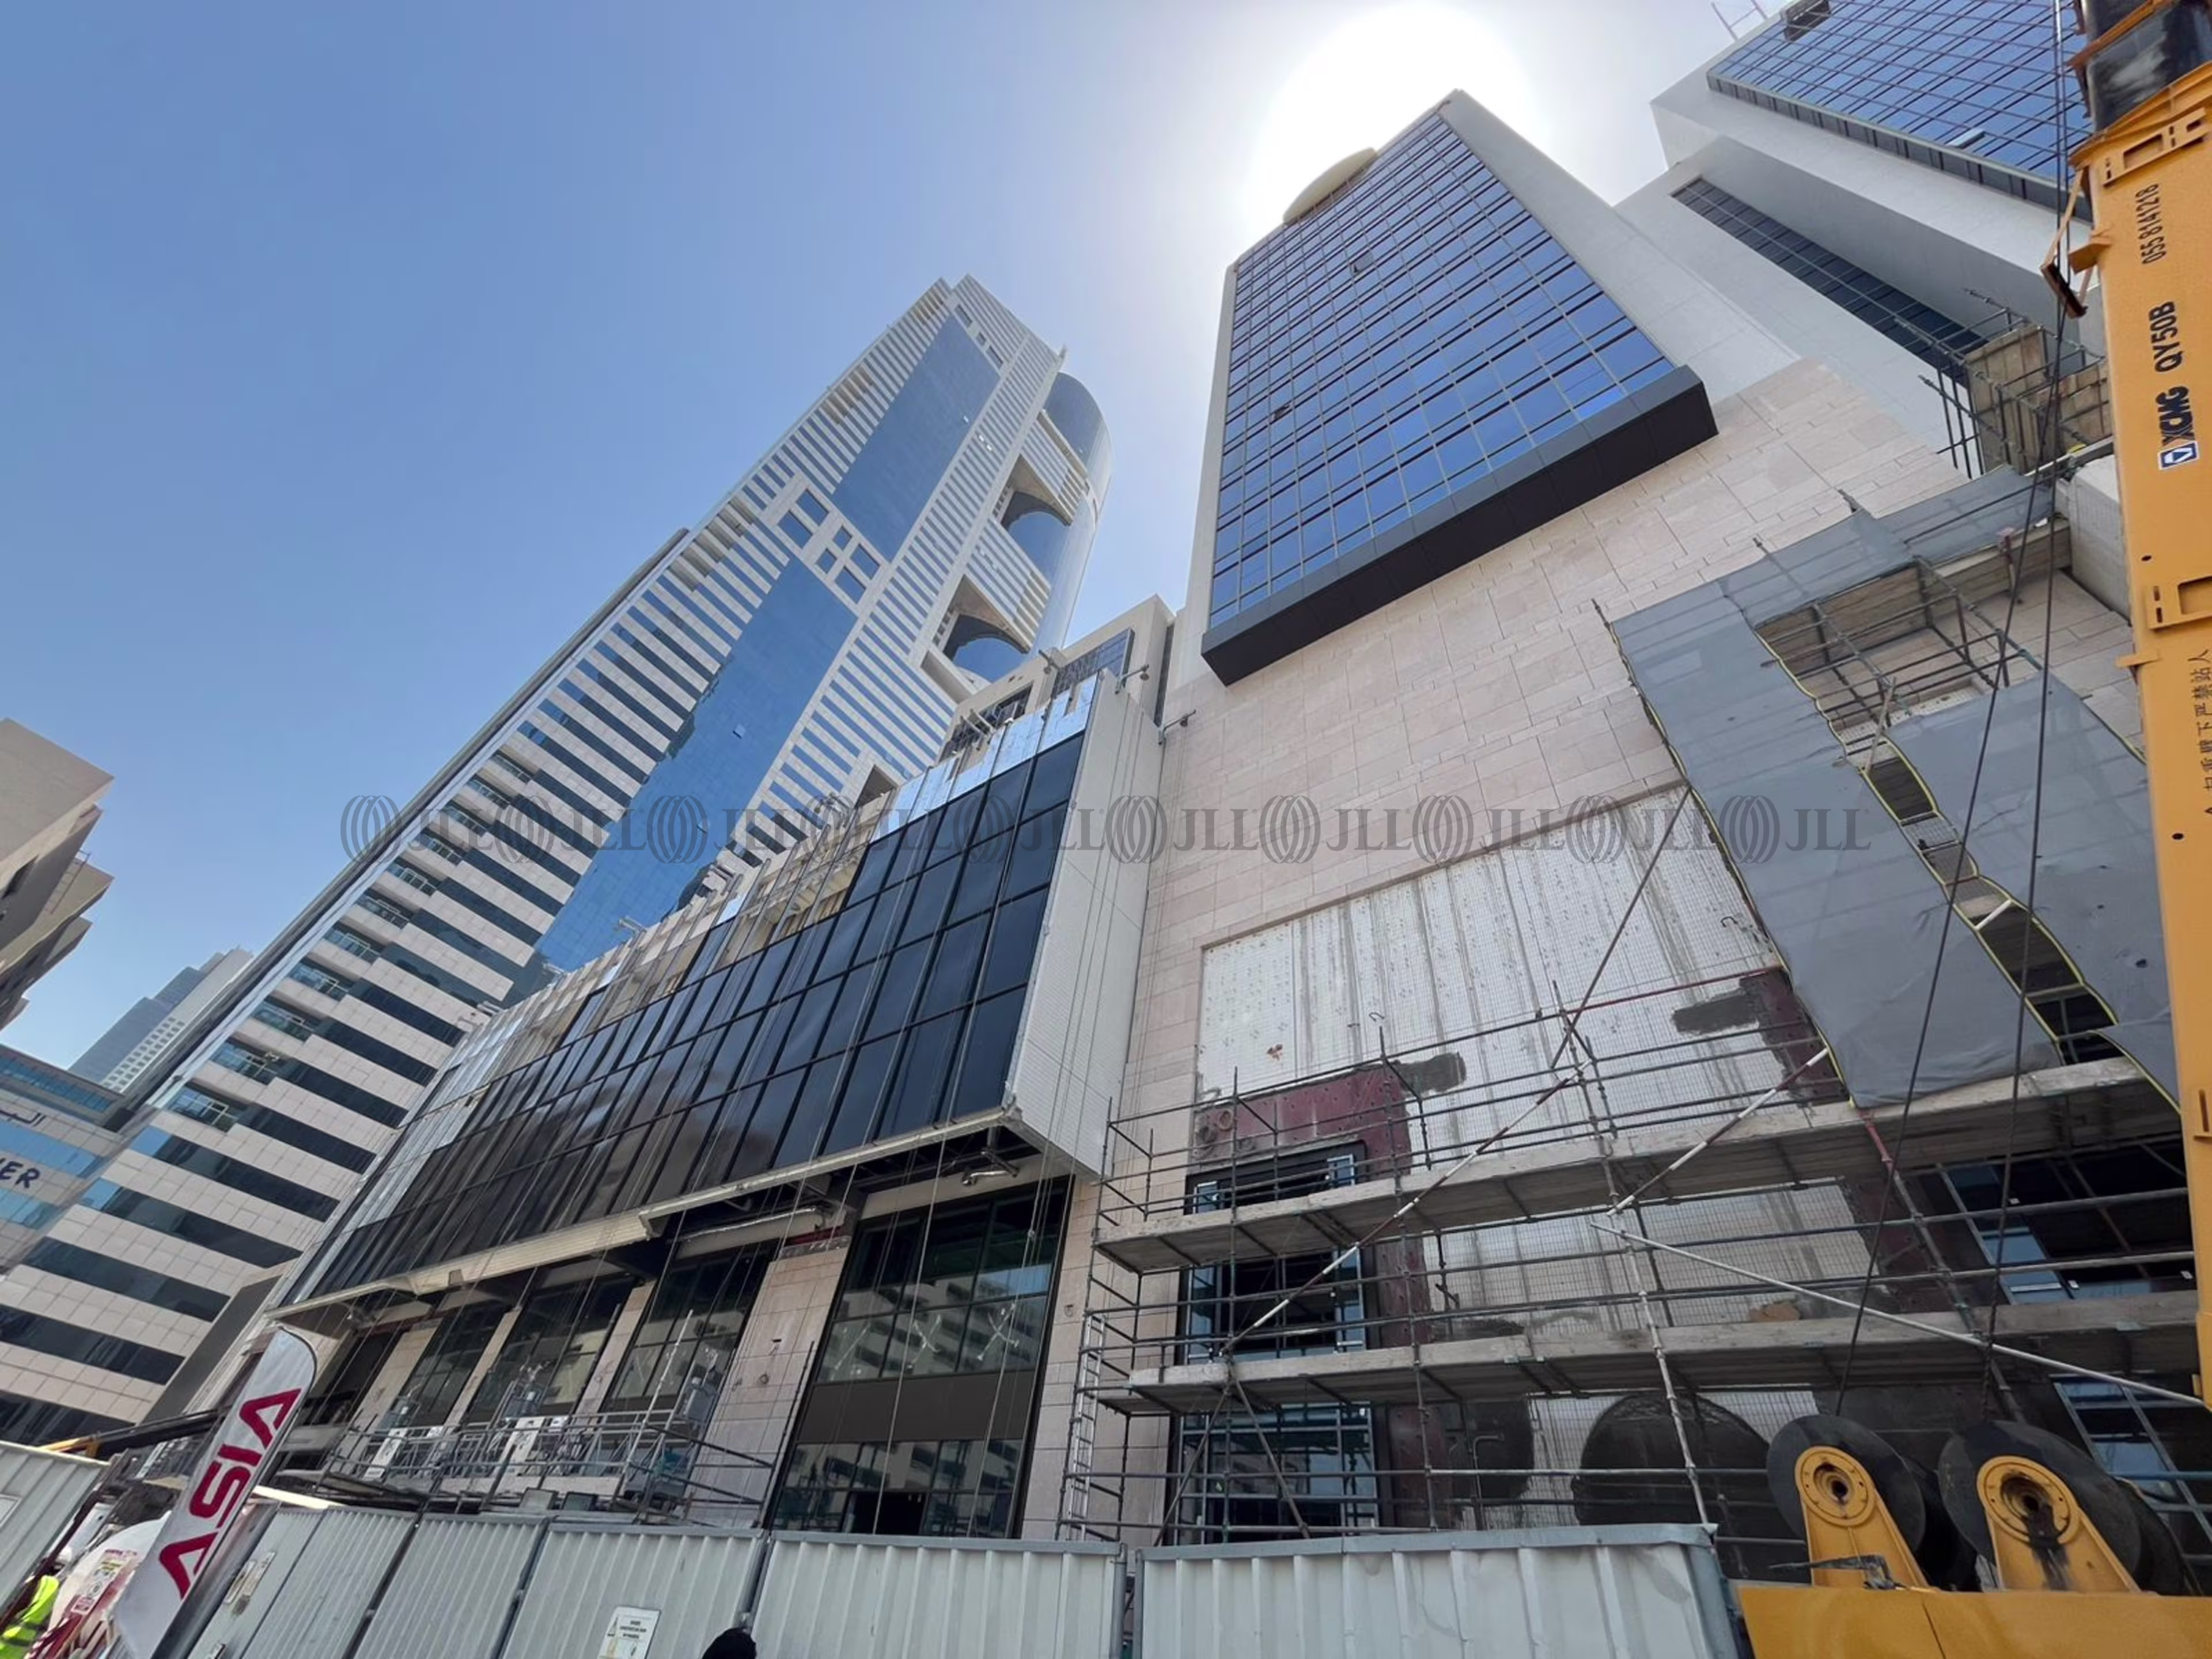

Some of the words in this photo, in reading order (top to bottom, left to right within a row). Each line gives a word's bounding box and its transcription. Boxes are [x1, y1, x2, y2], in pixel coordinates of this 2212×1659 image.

[2141, 236, 2166, 264] 055
[2148, 301, 2186, 373] QY50B
[2155, 386, 2196, 446] XCMG
[0, 1158, 40, 1188] ER
[159, 1388, 302, 1602] ASIA
